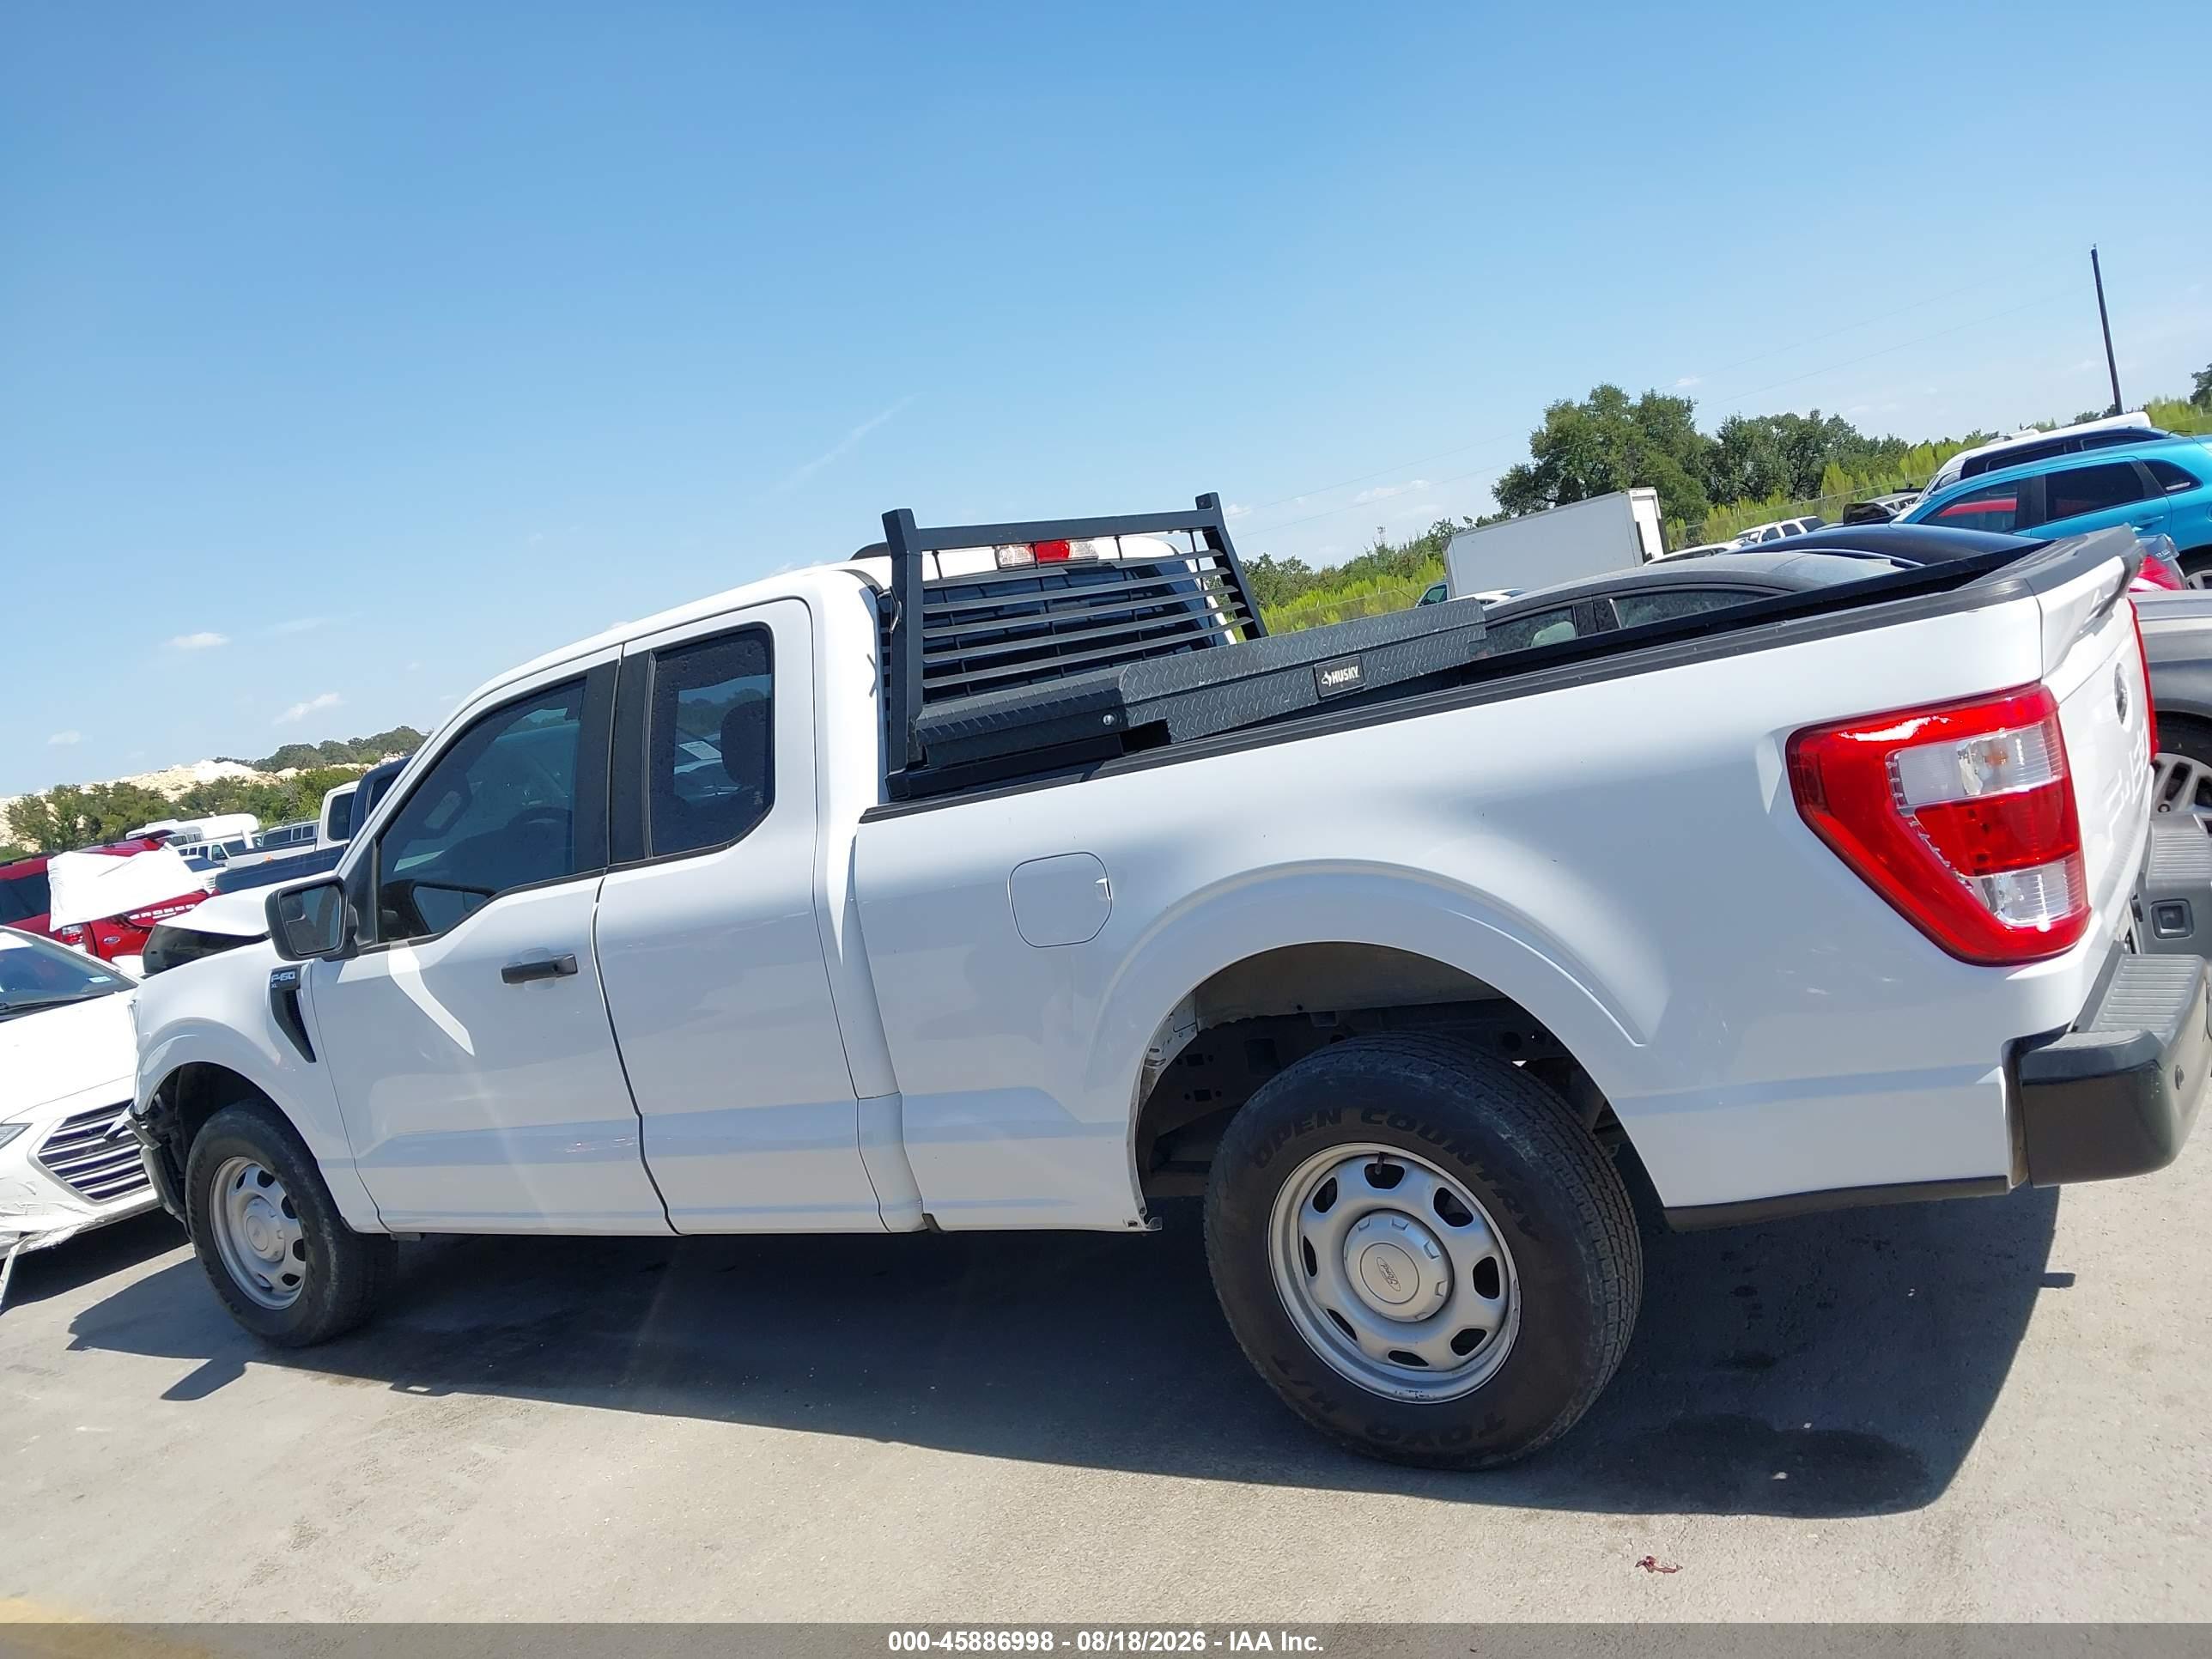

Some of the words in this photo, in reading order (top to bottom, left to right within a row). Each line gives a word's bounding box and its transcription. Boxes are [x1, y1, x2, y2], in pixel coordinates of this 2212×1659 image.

[1331, 665, 1359, 684] HUSKY
[1250, 1106, 1342, 1170] OPEN
[1359, 1106, 1542, 1243] COUNTRY
